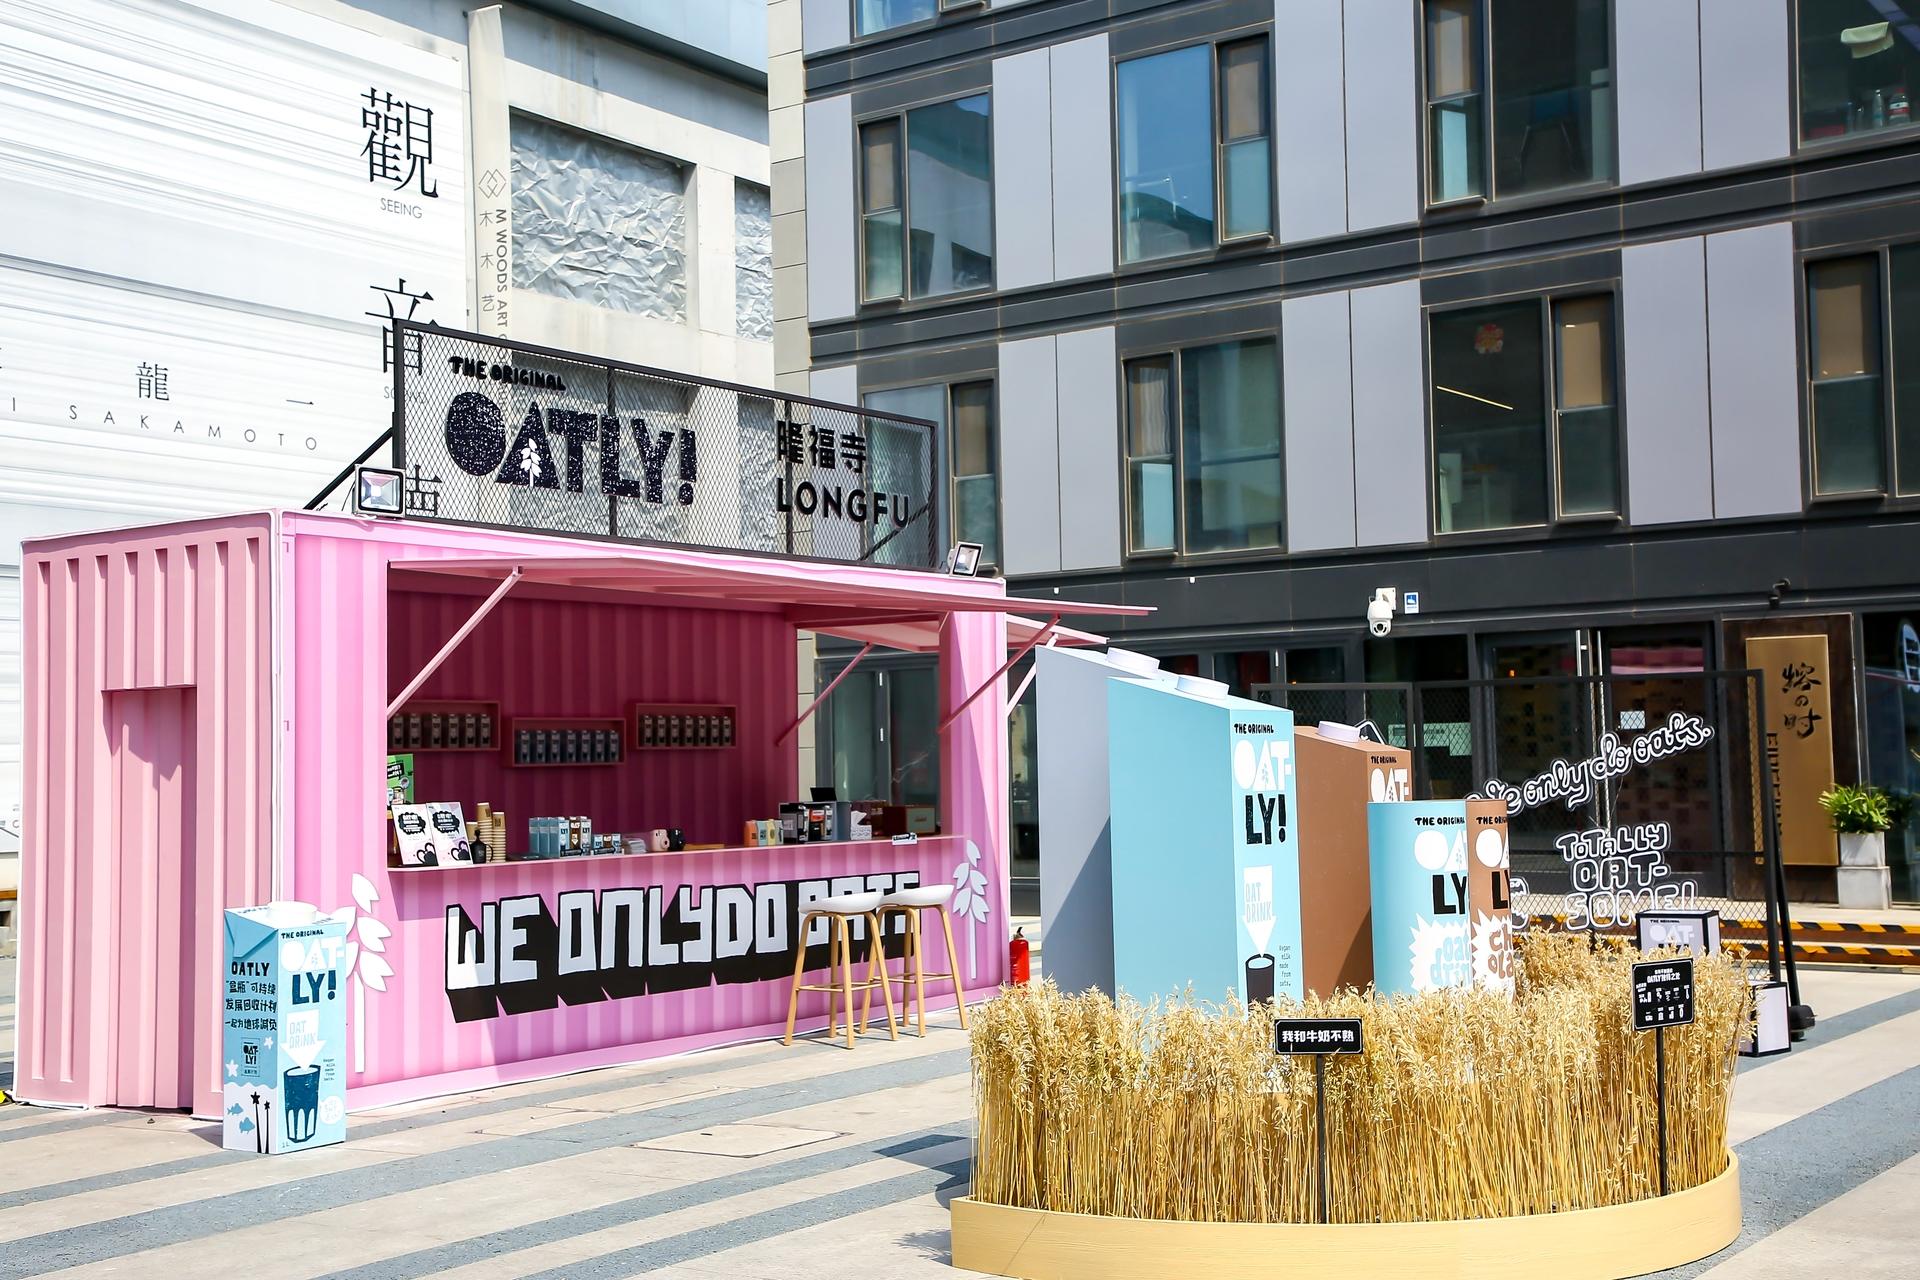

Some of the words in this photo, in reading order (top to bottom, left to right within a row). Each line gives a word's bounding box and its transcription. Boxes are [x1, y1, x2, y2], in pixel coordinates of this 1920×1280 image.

[360, 86, 439, 198] 觀
[380, 197, 422, 219] SEEING
[496, 208, 507, 224] M
[496, 229, 508, 293] WOODS
[364, 277, 434, 376] 音
[497, 299, 508, 327] ART
[448, 355, 488, 380] THE
[490, 364, 567, 391] ORIGINAL
[69, 404, 318, 451] SAKAMOTO
[445, 391, 698, 507] OATLY!
[777, 420, 867, 474] 隆福寺
[776, 478, 909, 528] LONGFU
[1233, 723, 1247, 734] THE
[1248, 723, 1274, 734] ORIGINAL
[1233, 739, 1292, 791] OAT-
[1524, 759, 1592, 810] only
[1590, 733, 1632, 780] do
[1633, 712, 1714, 763] oats.
[1245, 793, 1287, 845] LY!
[1414, 816, 1435, 825] THE
[1476, 816, 1493, 825] THE
[1556, 823, 1670, 862] TOTALLY
[1573, 851, 1669, 892] OAT-
[1245, 882, 1261, 902] OAT
[1246, 901, 1272, 923] DRINK
[281, 931, 295, 940] THE
[295, 929, 324, 938] ORIGINAL
[446, 893, 543, 1002] WE
[231, 961, 271, 977] OATLY
[291, 970, 337, 1005] LY!
[225, 998, 277, 1014] 发展回收计划
[289, 1032, 317, 1049] DRINK
[290, 1020, 307, 1035] OAT
[1281, 1029, 1355, 1043] 我和牛奶不熟
[245, 1054, 257, 1065] LY!
